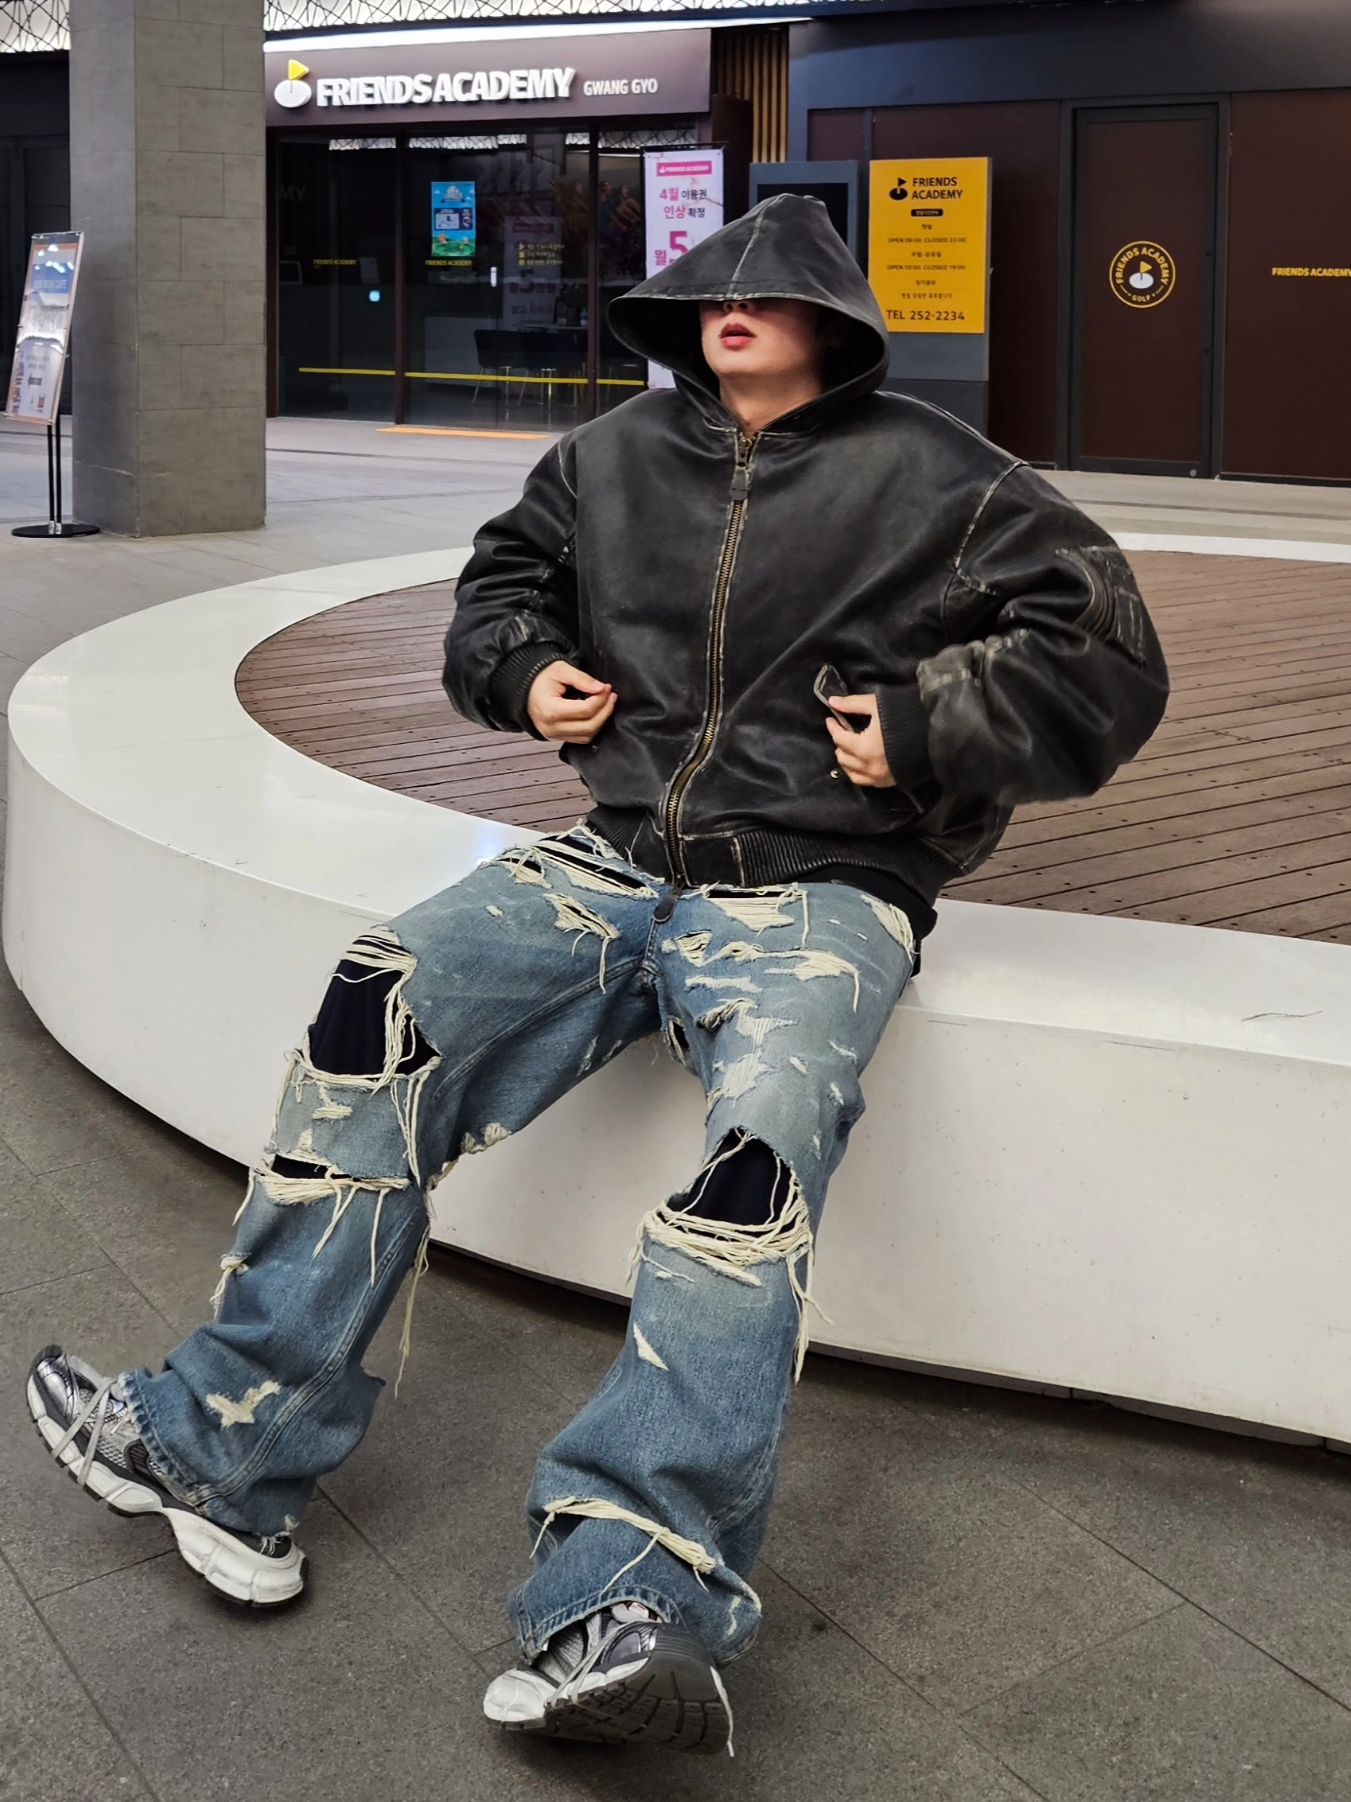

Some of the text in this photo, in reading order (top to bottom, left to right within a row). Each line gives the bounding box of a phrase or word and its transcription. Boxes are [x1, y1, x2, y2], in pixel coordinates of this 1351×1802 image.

[316, 66, 658, 107] FRIENDS ACADEMY GWANG GYO
[912, 177, 958, 187] FRIENDS
[659, 187, 707, 201] 4월 이용권
[911, 189, 963, 200] ACADEMY
[663, 206, 705, 219] 인상 확정
[654, 250, 667, 266] 월
[1115, 246, 1170, 285] FRIENDS ACADEMY
[1272, 267, 1310, 277] FRIENDS
[1131, 294, 1151, 303] GOLF
[886, 309, 966, 321] TEL 252-2234
